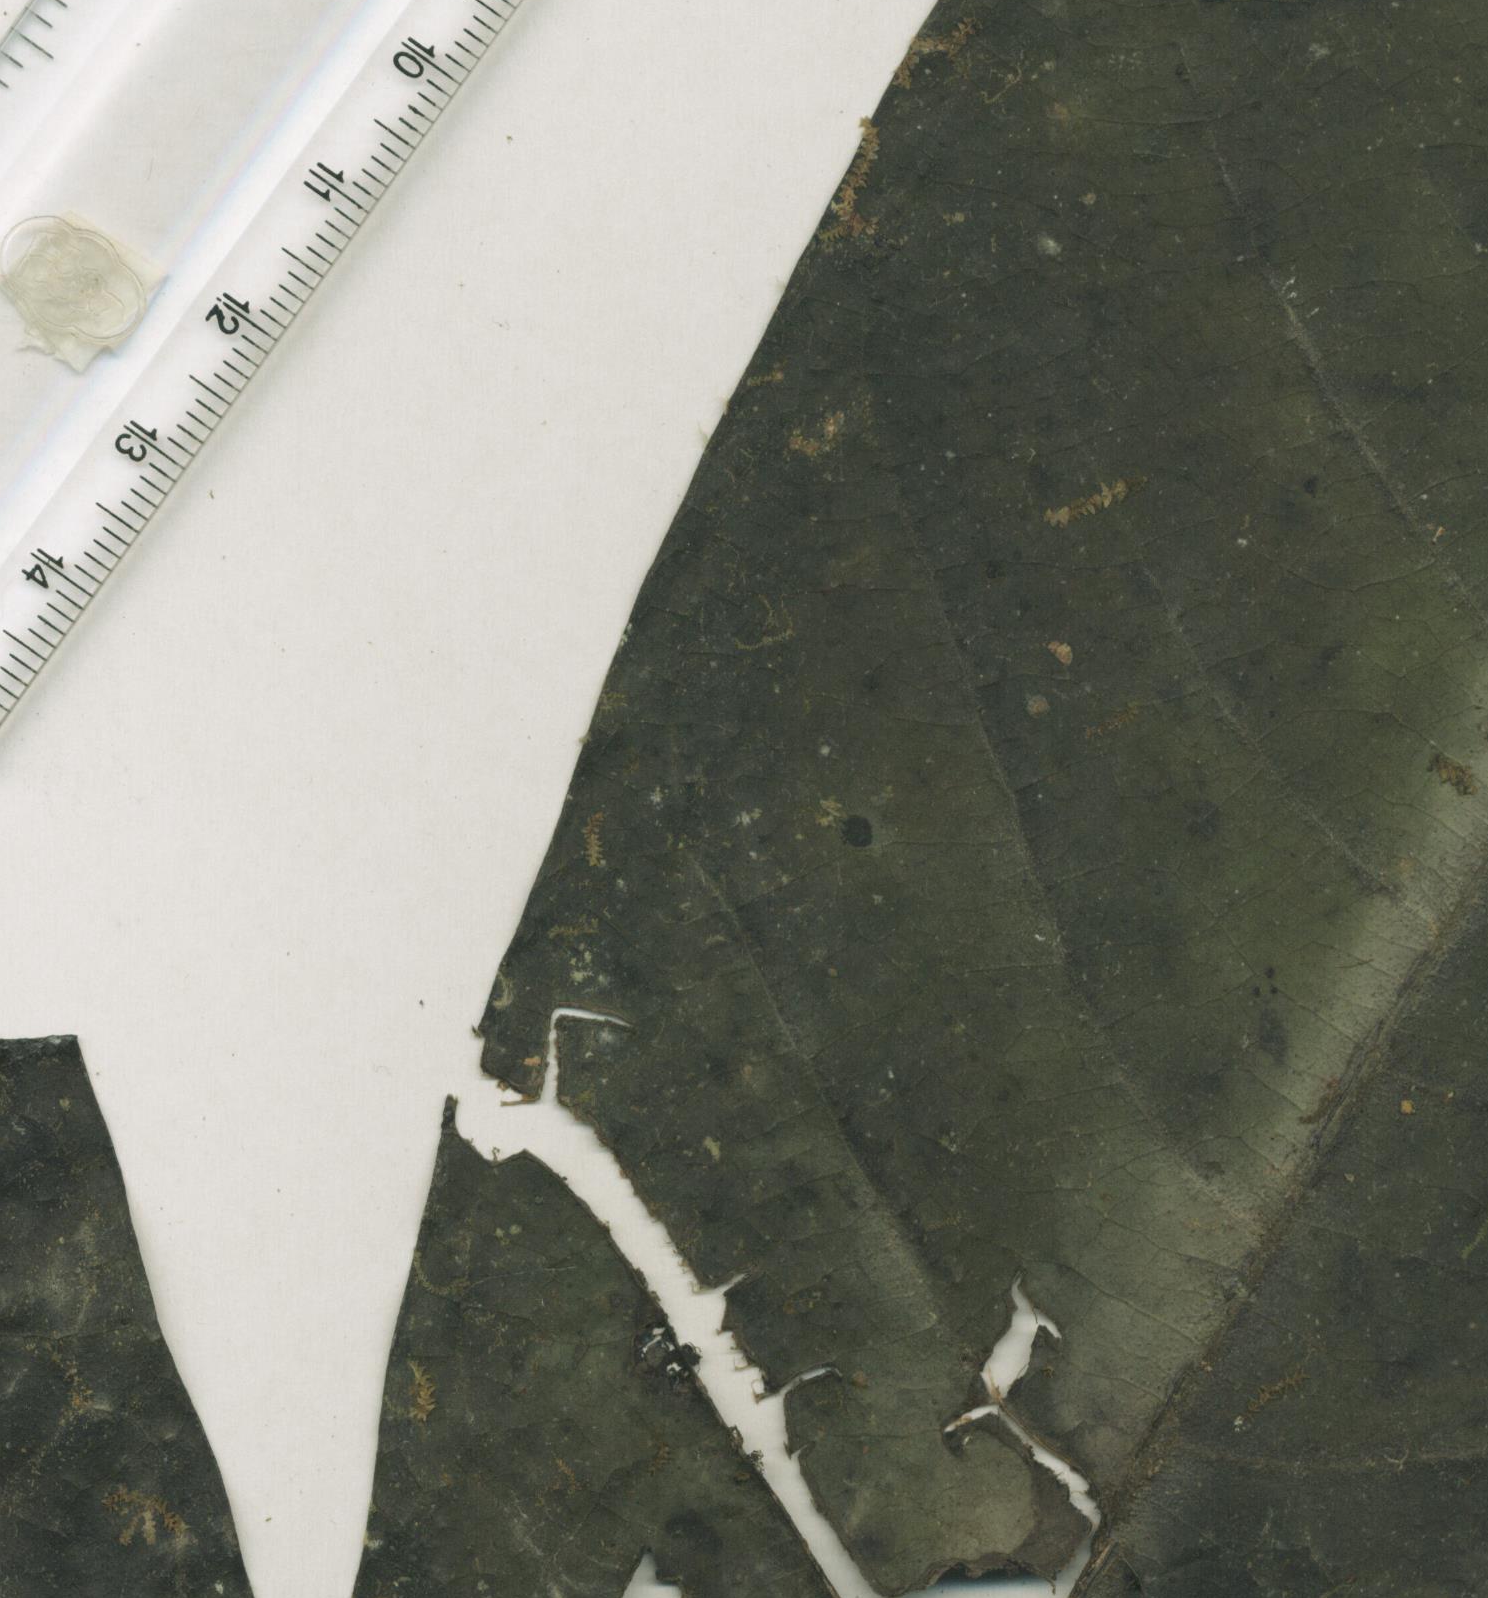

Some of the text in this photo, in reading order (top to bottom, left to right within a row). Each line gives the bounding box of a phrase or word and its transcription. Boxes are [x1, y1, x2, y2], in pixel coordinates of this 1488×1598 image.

[392, 36, 437, 80] 10
[303, 162, 345, 202] 11
[204, 292, 252, 336] 12
[114, 420, 159, 464] 13
[22, 548, 65, 590] 14
